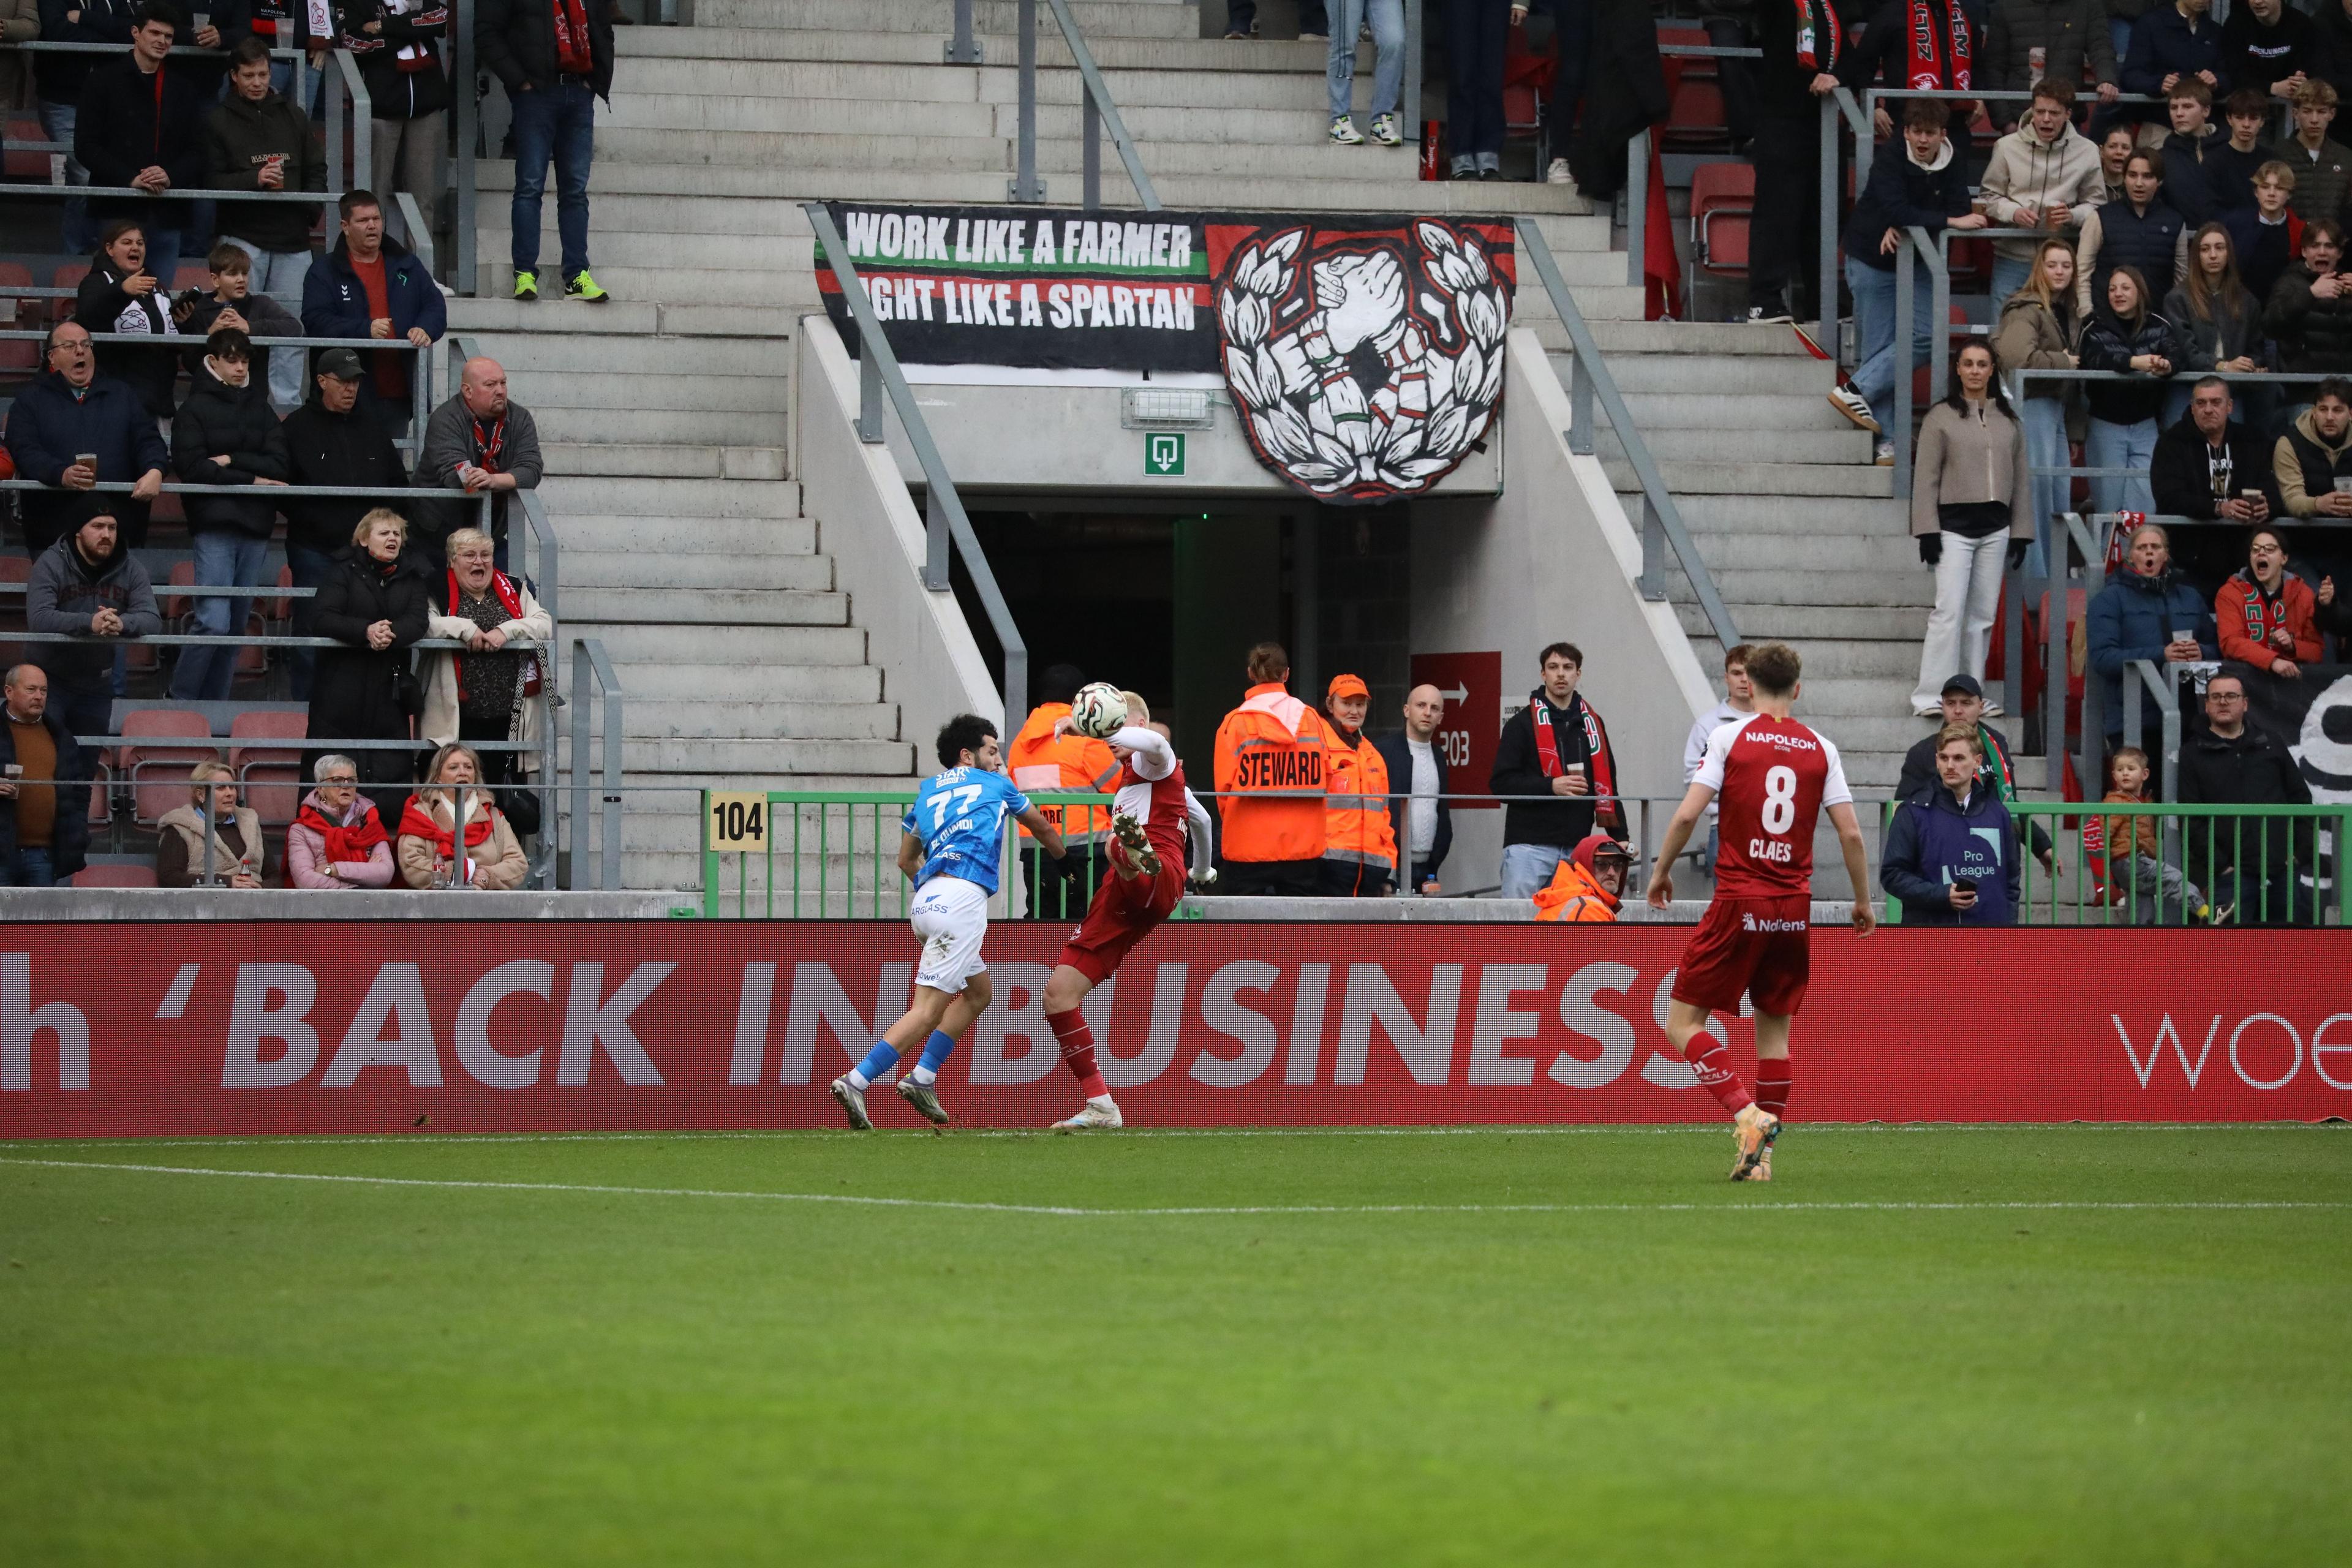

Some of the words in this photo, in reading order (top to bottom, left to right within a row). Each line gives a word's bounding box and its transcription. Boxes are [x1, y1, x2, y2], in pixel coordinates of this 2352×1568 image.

[1913, 0, 1934, 62] ZULT
[846, 212, 950, 260] WORK
[956, 218, 1026, 263] LIKE
[1033, 220, 1057, 264] A
[1063, 221, 1191, 267] FARMER
[847, 277, 935, 322] GHT
[943, 281, 1014, 326] LIKE
[1020, 284, 1043, 327] A
[1049, 283, 1195, 331] SPARTAN
[1439, 730, 1470, 767] 203
[1746, 731, 1816, 751] NAPOLEON
[937, 778, 957, 786] CASINO
[1238, 751, 1321, 787] STEWARD
[926, 783, 982, 831] 77
[1762, 765, 1797, 835] 8
[714, 801, 763, 841] 104
[1749, 838, 1792, 862] CLAES
[1964, 850, 1984, 862] Pro
[1954, 864, 1995, 878] League
[911, 903, 949, 916] ARGLASS
[728, 961, 915, 1087] IN
